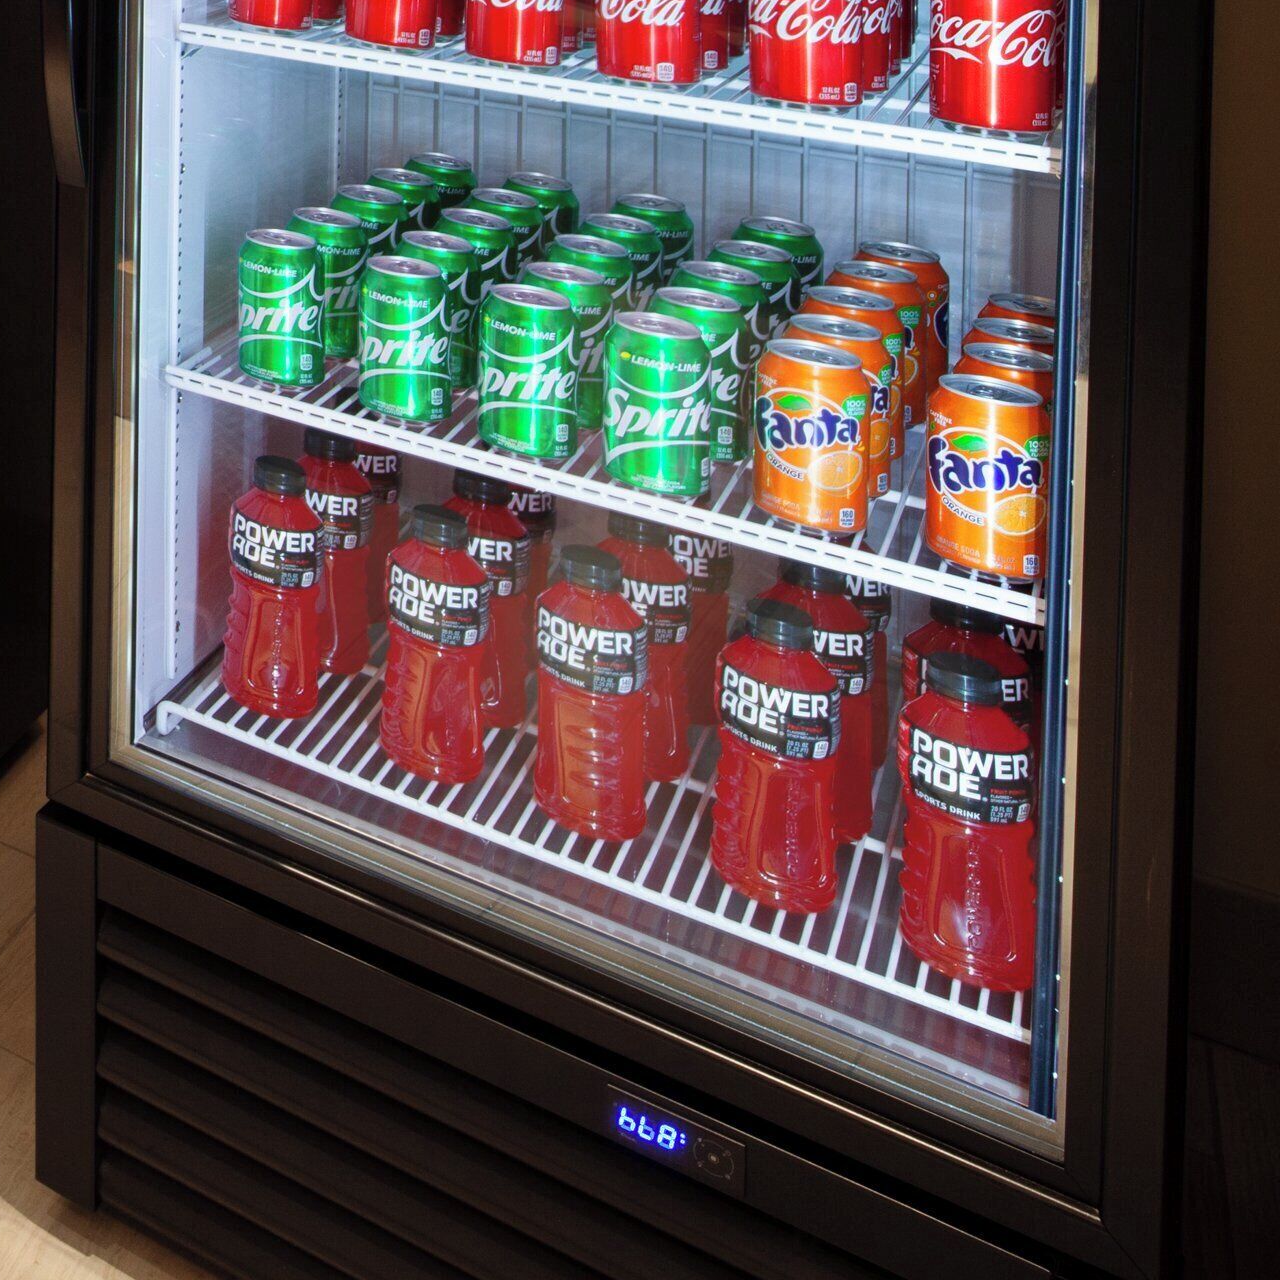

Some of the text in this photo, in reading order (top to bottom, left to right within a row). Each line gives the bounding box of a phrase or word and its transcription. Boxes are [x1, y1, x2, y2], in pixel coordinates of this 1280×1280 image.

[757, 395, 860, 450] Fanta
[766, 451, 804, 481] ORANGE
[929, 436, 1041, 491] Fanta
[841, 511, 854, 519] 160
[943, 494, 984, 525] ORANGE
[234, 514, 314, 554] POWER
[254, 572, 275, 584] DRINK
[1024, 556, 1038, 565] 160
[390, 565, 478, 609] POWER
[412, 628, 434, 641] DRINK
[538, 607, 633, 655] POWER
[723, 665, 828, 719] POWER
[913, 729, 1029, 781] POWER
[915, 789, 981, 820] SPORTS DRINK
